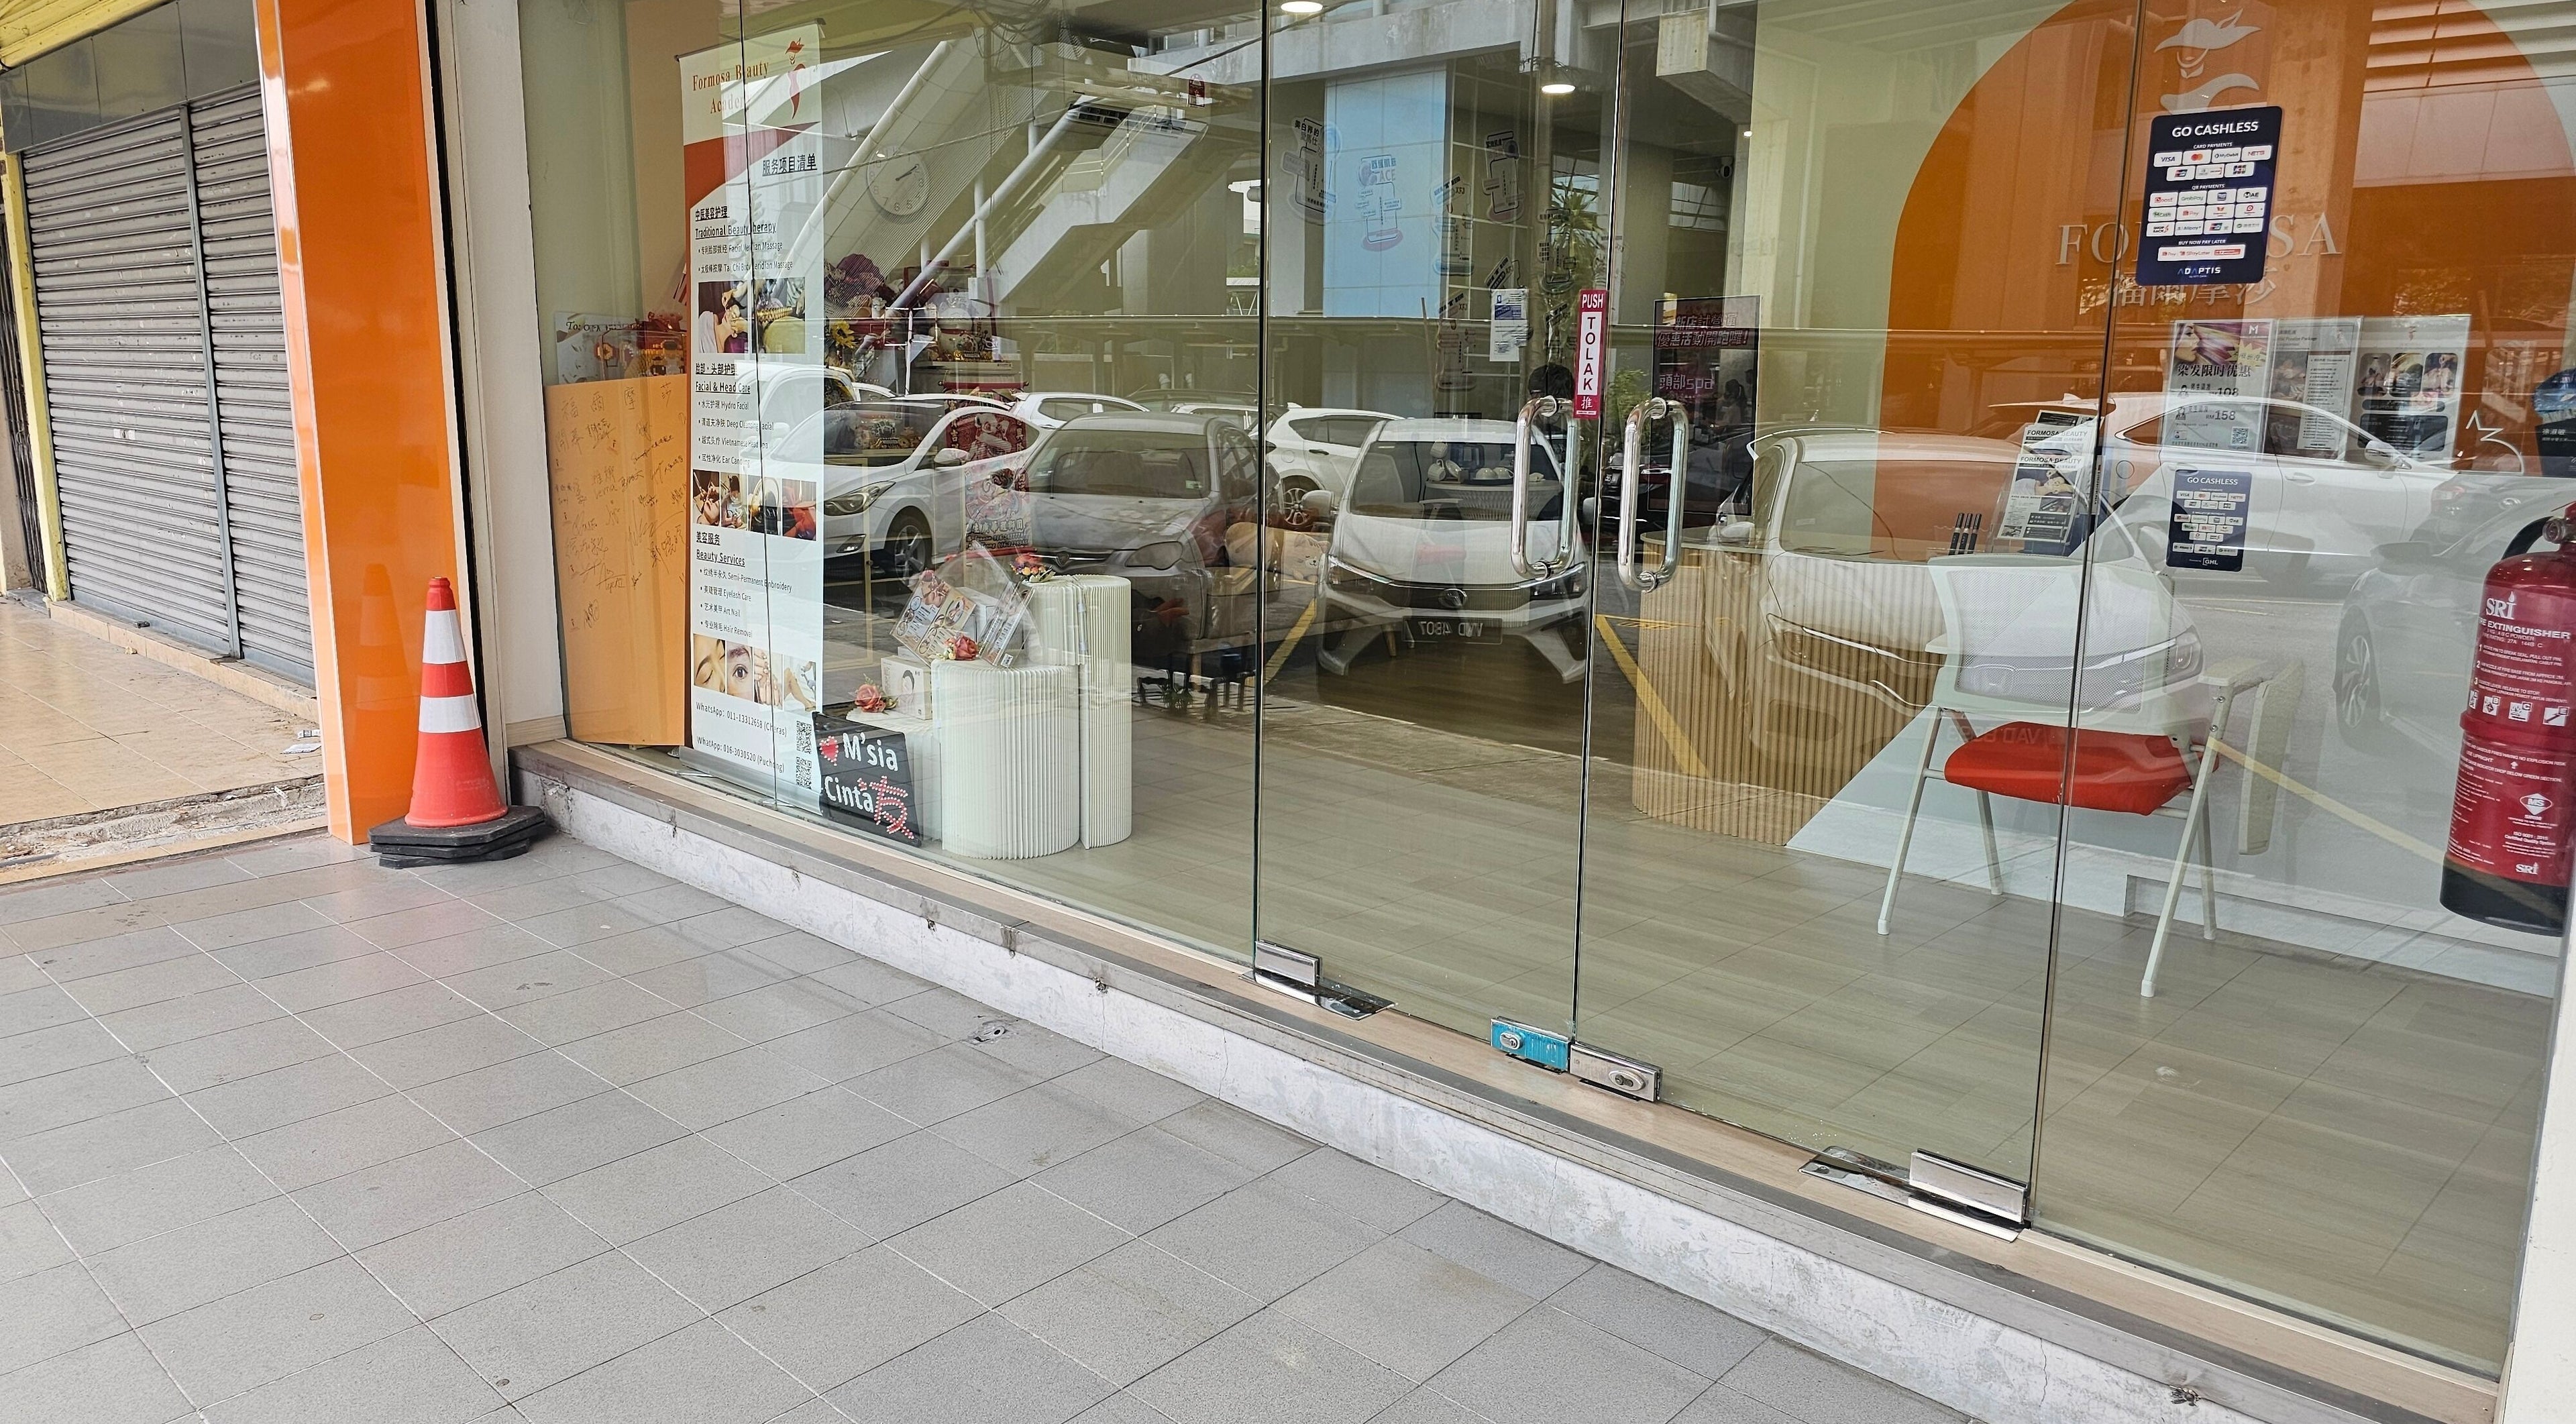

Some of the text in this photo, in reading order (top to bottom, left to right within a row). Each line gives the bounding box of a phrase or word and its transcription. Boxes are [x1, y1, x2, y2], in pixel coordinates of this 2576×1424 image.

[692, 61, 769, 91] Formosa Bauty
[2171, 121, 2259, 138] GO CASHLESS
[763, 154, 816, 175] 服务项目清单
[696, 222, 776, 238] Traditional Beauty herapy
[2055, 212, 2342, 266] FOSA
[763, 242, 782, 252] Massage
[754, 261, 772, 270] eridian
[1582, 294, 1604, 309] PUSH
[1583, 317, 1596, 390] TOLAK
[2178, 364, 2251, 377] 染发限时优惠
[696, 381, 712, 392] Facial
[720, 382, 737, 392] Head
[738, 383, 751, 393] Care
[721, 401, 736, 410] Hydro
[737, 402, 749, 410] Facial
[1581, 396, 1592, 410] 推
[696, 549, 745, 565] Beauty Services
[723, 590, 741, 599] Eyelash
[742, 593, 751, 602] Care
[731, 608, 741, 617] Nail
[724, 624, 733, 633] Hair
[2487, 620, 2571, 639] EXTINGUISHER
[696, 701, 724, 718] WhatsApp:
[843, 732, 898, 771] M'sia
[824, 776, 873, 813] Cinta
[2528, 798, 2544, 807] MS
